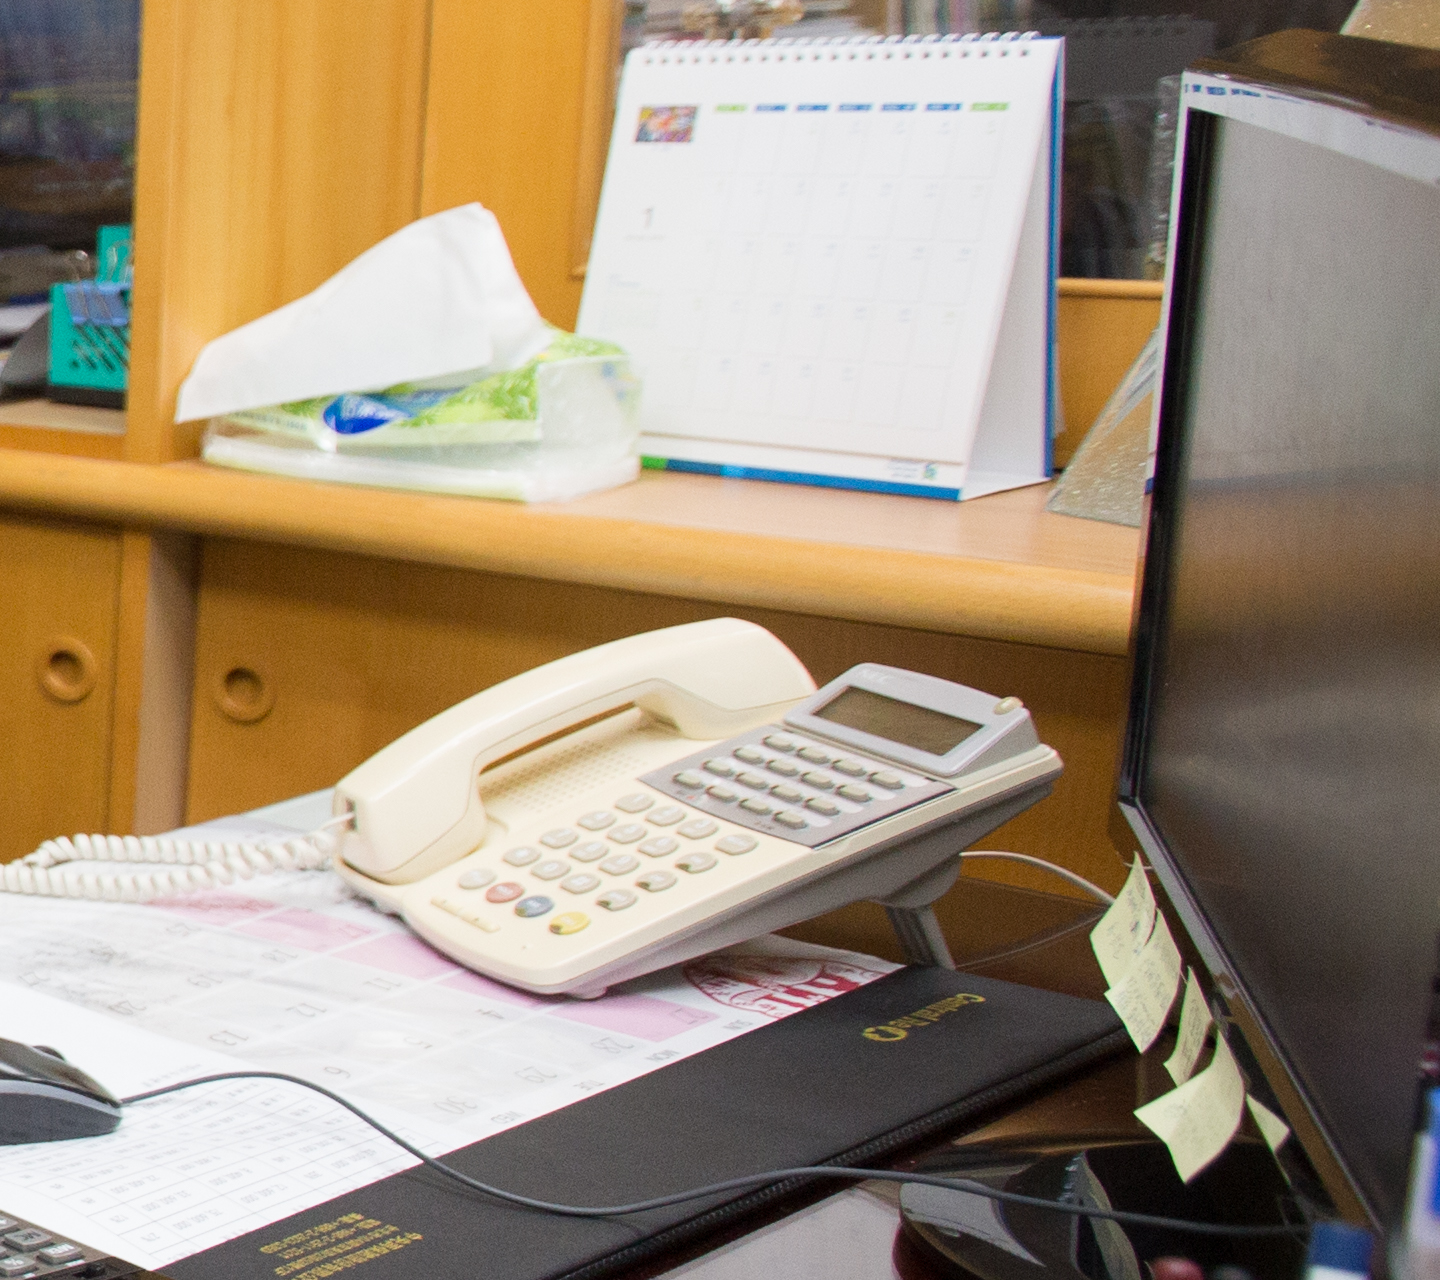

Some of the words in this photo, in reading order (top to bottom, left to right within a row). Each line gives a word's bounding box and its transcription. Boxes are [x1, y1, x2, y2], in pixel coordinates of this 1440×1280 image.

[260, 941, 299, 964] 18
[185, 970, 224, 989] 19
[362, 968, 403, 1000] 11
[282, 1001, 328, 1019] 12
[206, 1029, 250, 1053] 13
[321, 1065, 352, 1080] 6
[514, 1065, 558, 1085] 29
[432, 1096, 479, 1116] 30
